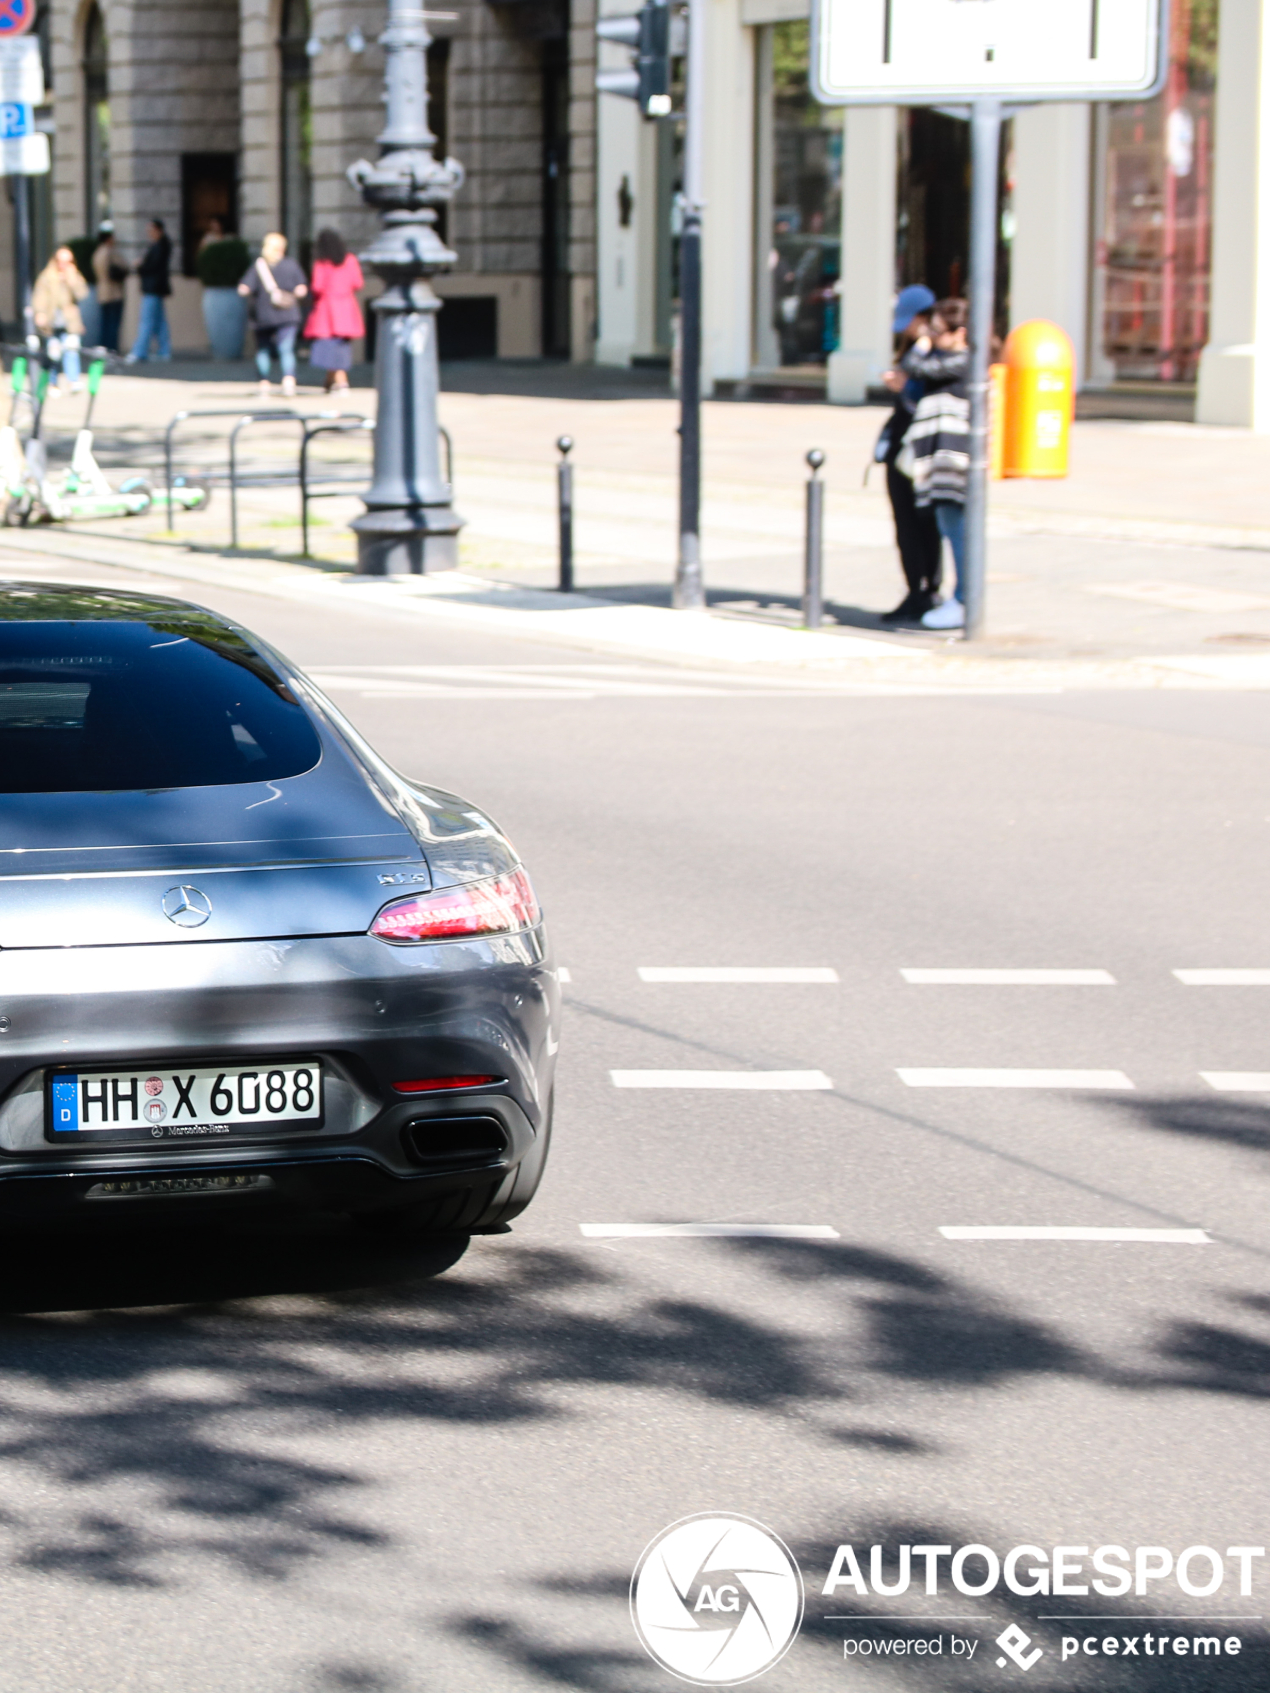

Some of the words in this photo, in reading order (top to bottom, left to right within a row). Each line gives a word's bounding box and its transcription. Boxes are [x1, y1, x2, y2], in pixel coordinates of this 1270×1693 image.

[81, 1077, 139, 1123] HH
[172, 1074, 198, 1119] X
[210, 1068, 315, 1117] 6088
[60, 1108, 72, 1122] D
[168, 1123, 230, 1136] Mercedes-Benz
